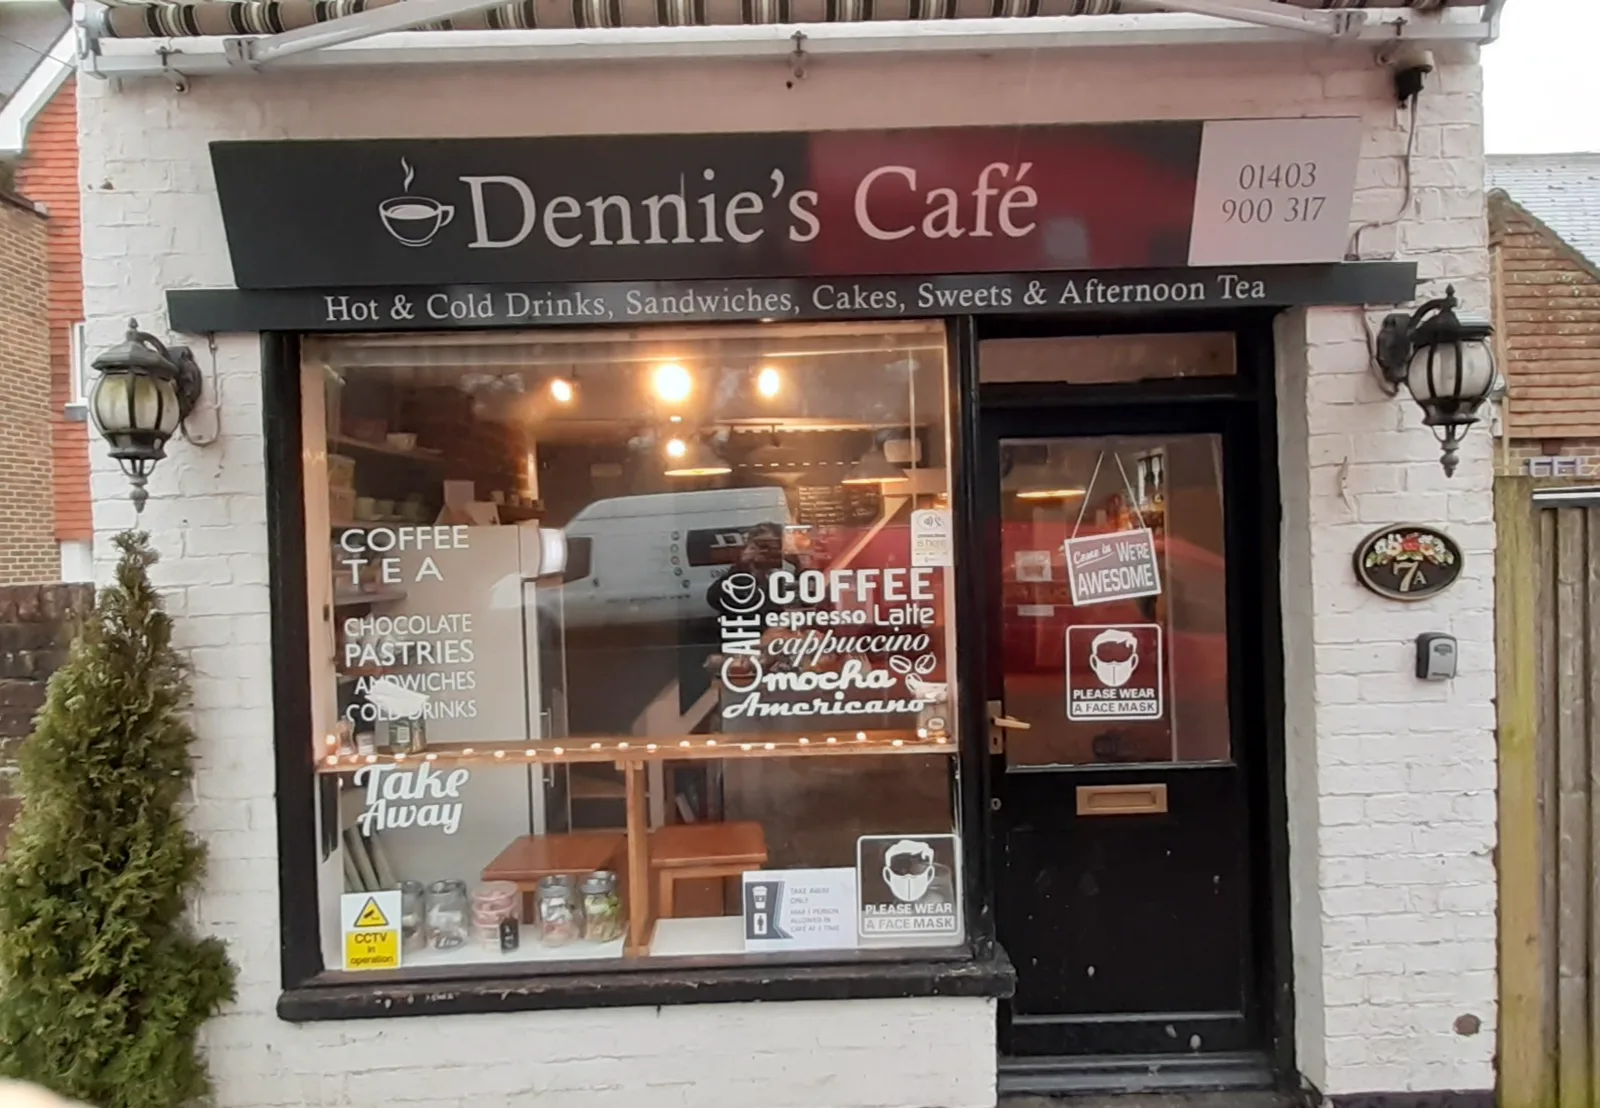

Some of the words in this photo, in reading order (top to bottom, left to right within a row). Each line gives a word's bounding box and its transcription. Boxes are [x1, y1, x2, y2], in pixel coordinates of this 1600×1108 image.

[1238, 162, 1317, 191] 01403
[459, 168, 819, 249] Dennie's
[854, 161, 1038, 241] Café
[1221, 197, 1273, 225] 900
[1283, 196, 1326, 223] 317
[325, 296, 379, 322] Hot
[391, 295, 415, 321] &
[427, 292, 494, 320] Cold
[506, 289, 614, 321] Drinks,
[627, 287, 799, 317] Sandwiches,
[812, 285, 905, 312] Cakes,
[918, 282, 1012, 308] Sweets
[1023, 279, 1048, 306] &
[1059, 275, 1205, 305] Afternoon
[1218, 274, 1265, 300] Tea
[340, 525, 469, 553] COFFEE
[768, 567, 934, 604] COFFEE
[1078, 563, 1154, 597] AWESOME
[344, 614, 472, 637] CHOCOLATE
[765, 607, 867, 631] espresso
[874, 603, 935, 626] Latte
[345, 640, 475, 668] PASTRIES
[768, 626, 929, 667] cappuccino
[762, 659, 896, 691] mocha
[722, 691, 935, 718] Americano
[1073, 689, 1116, 700] PLEASE
[1119, 688, 1155, 699] WEAR
[1074, 703, 1083, 713] A
[1086, 702, 1115, 712] FACE
[1118, 701, 1155, 712] MASK
[354, 761, 469, 805] Take
[357, 799, 462, 837] Away
[865, 903, 911, 915] PLEASE
[914, 902, 952, 914] WEAR
[866, 918, 876, 930] A
[878, 917, 910, 929] FACE
[913, 916, 953, 928] MASK
[355, 932, 388, 944] CCTV
[350, 955, 394, 966] operation
